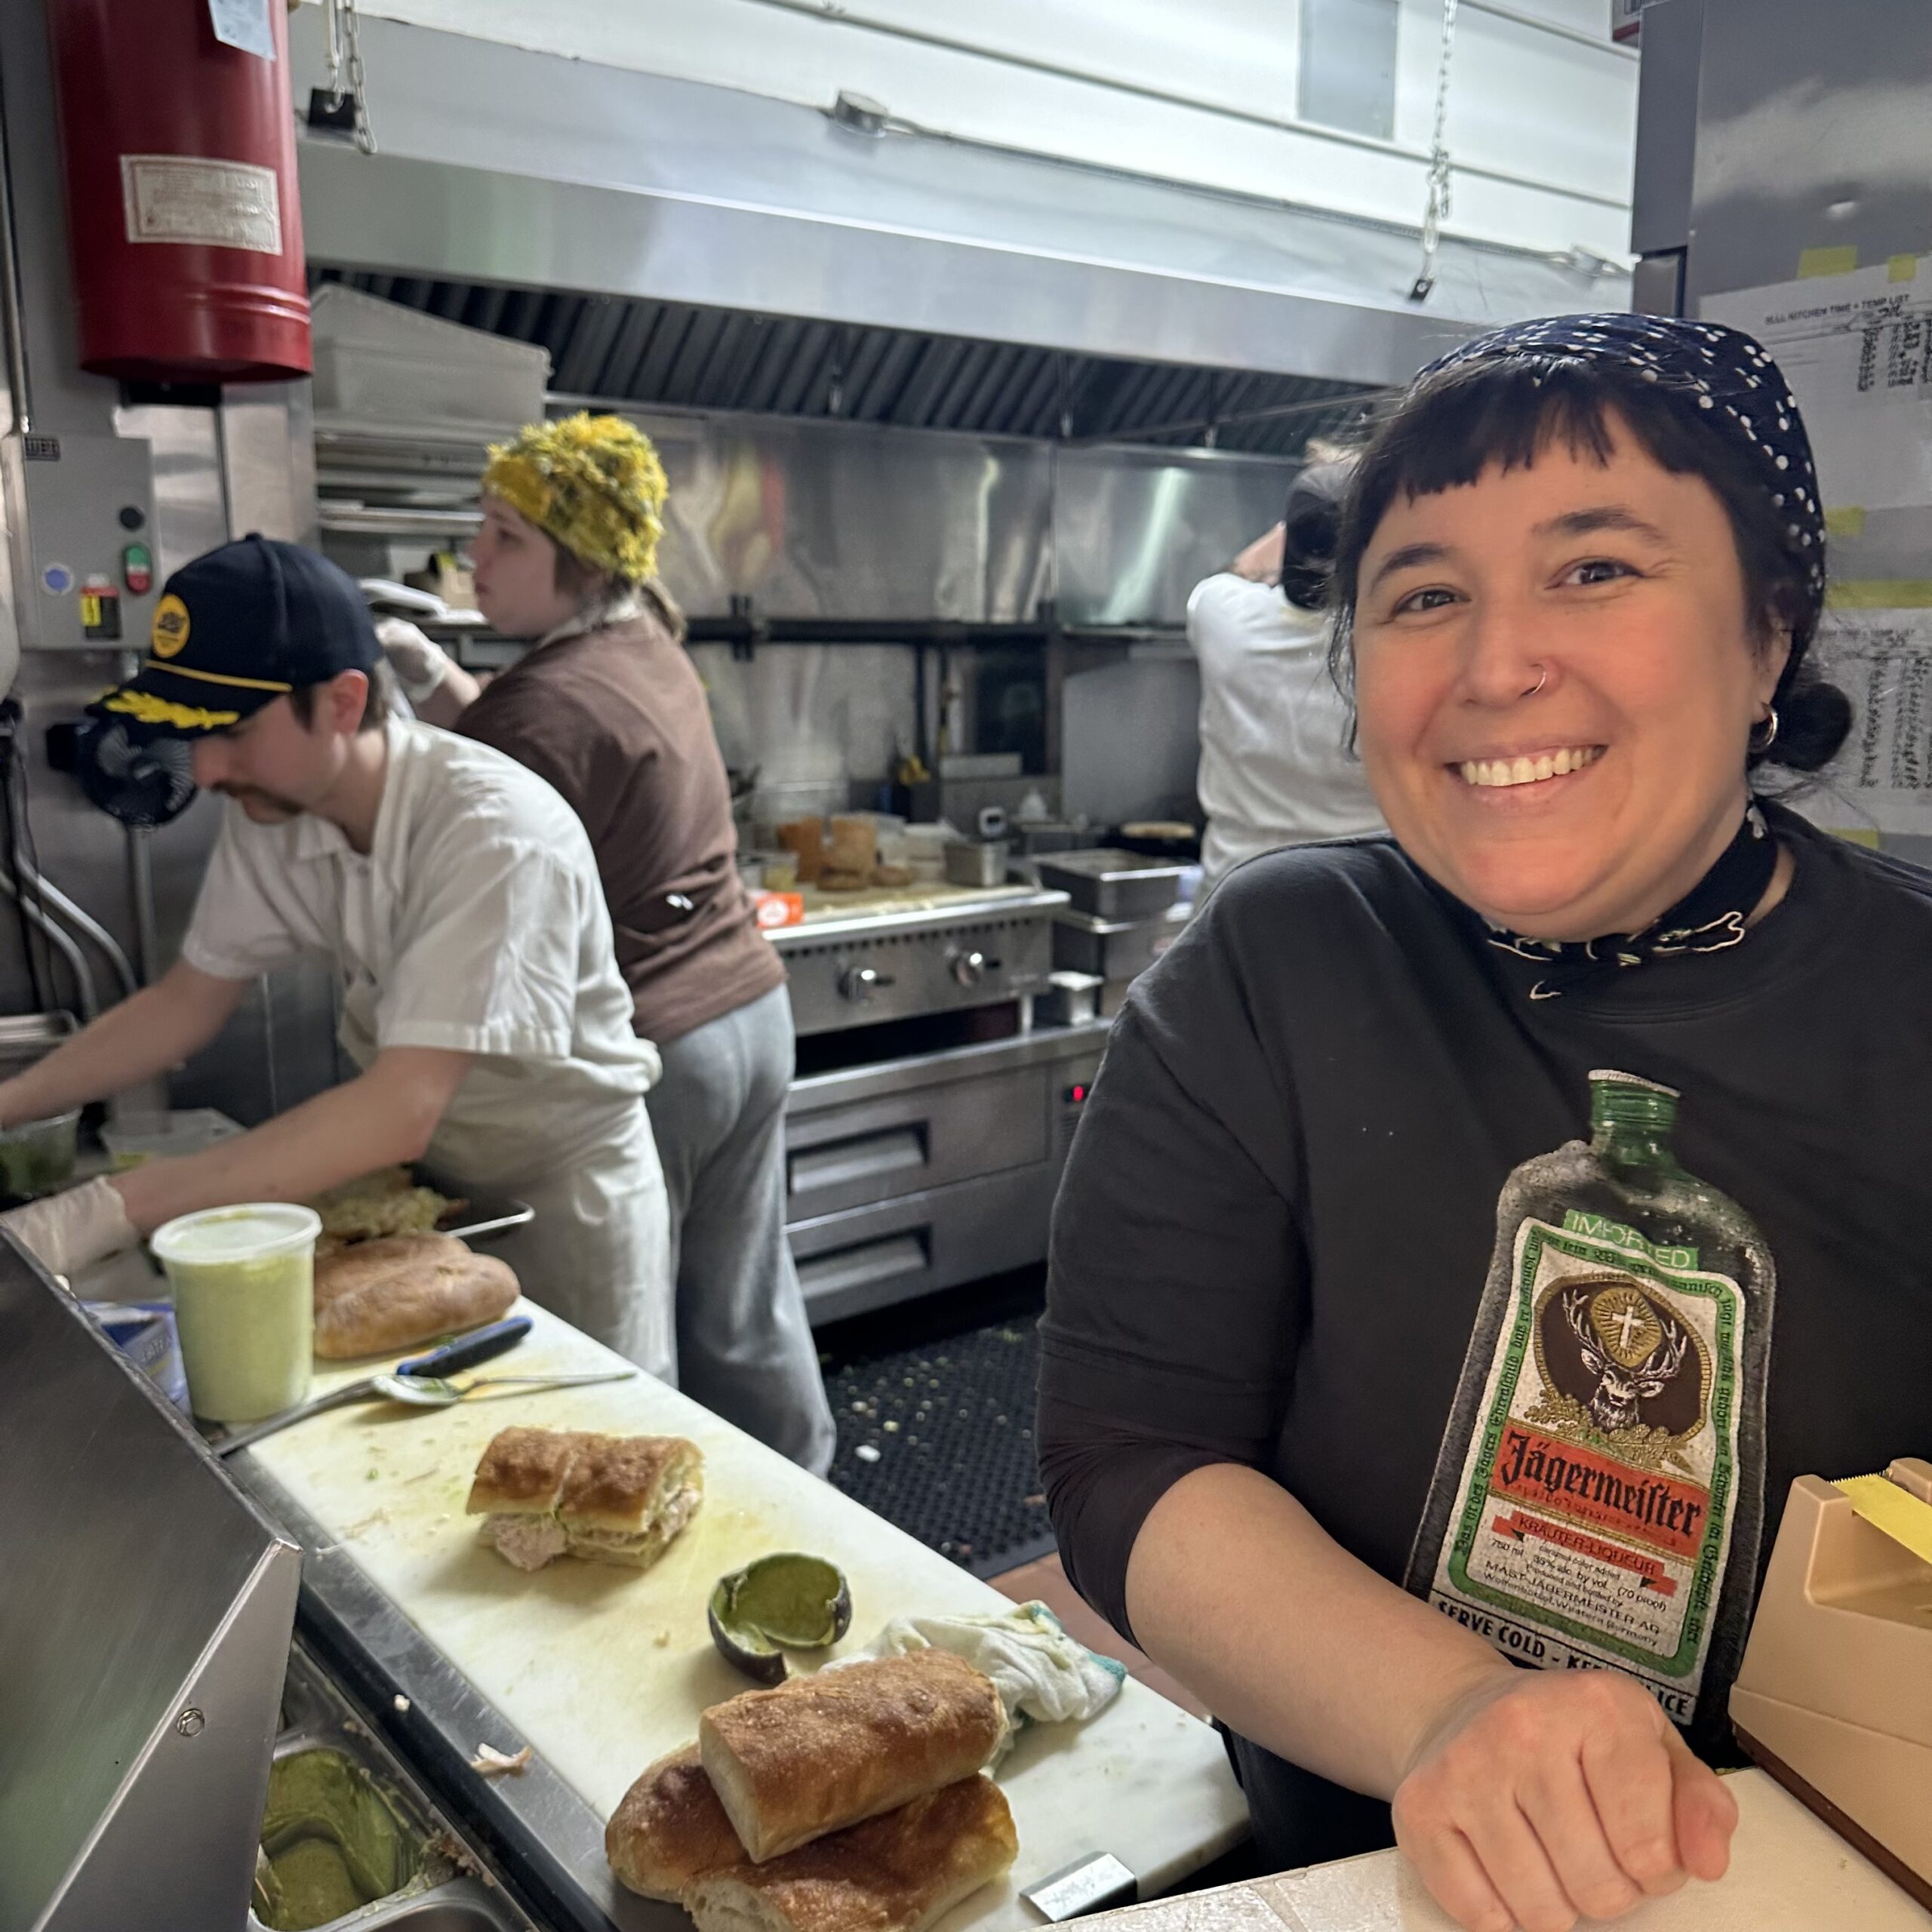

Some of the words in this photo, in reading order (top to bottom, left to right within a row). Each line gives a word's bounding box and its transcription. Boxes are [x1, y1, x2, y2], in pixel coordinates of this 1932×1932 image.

[1501, 1429, 1701, 1537] Jägermeister
[1492, 1539, 1510, 1551] 750
[1577, 1571, 1589, 1583] by
[1617, 1586, 1635, 1598] (70
[1639, 1620, 1660, 1635] AG
[1498, 1625, 1546, 1657] COLD
[1657, 1690, 1689, 1716] ICE
